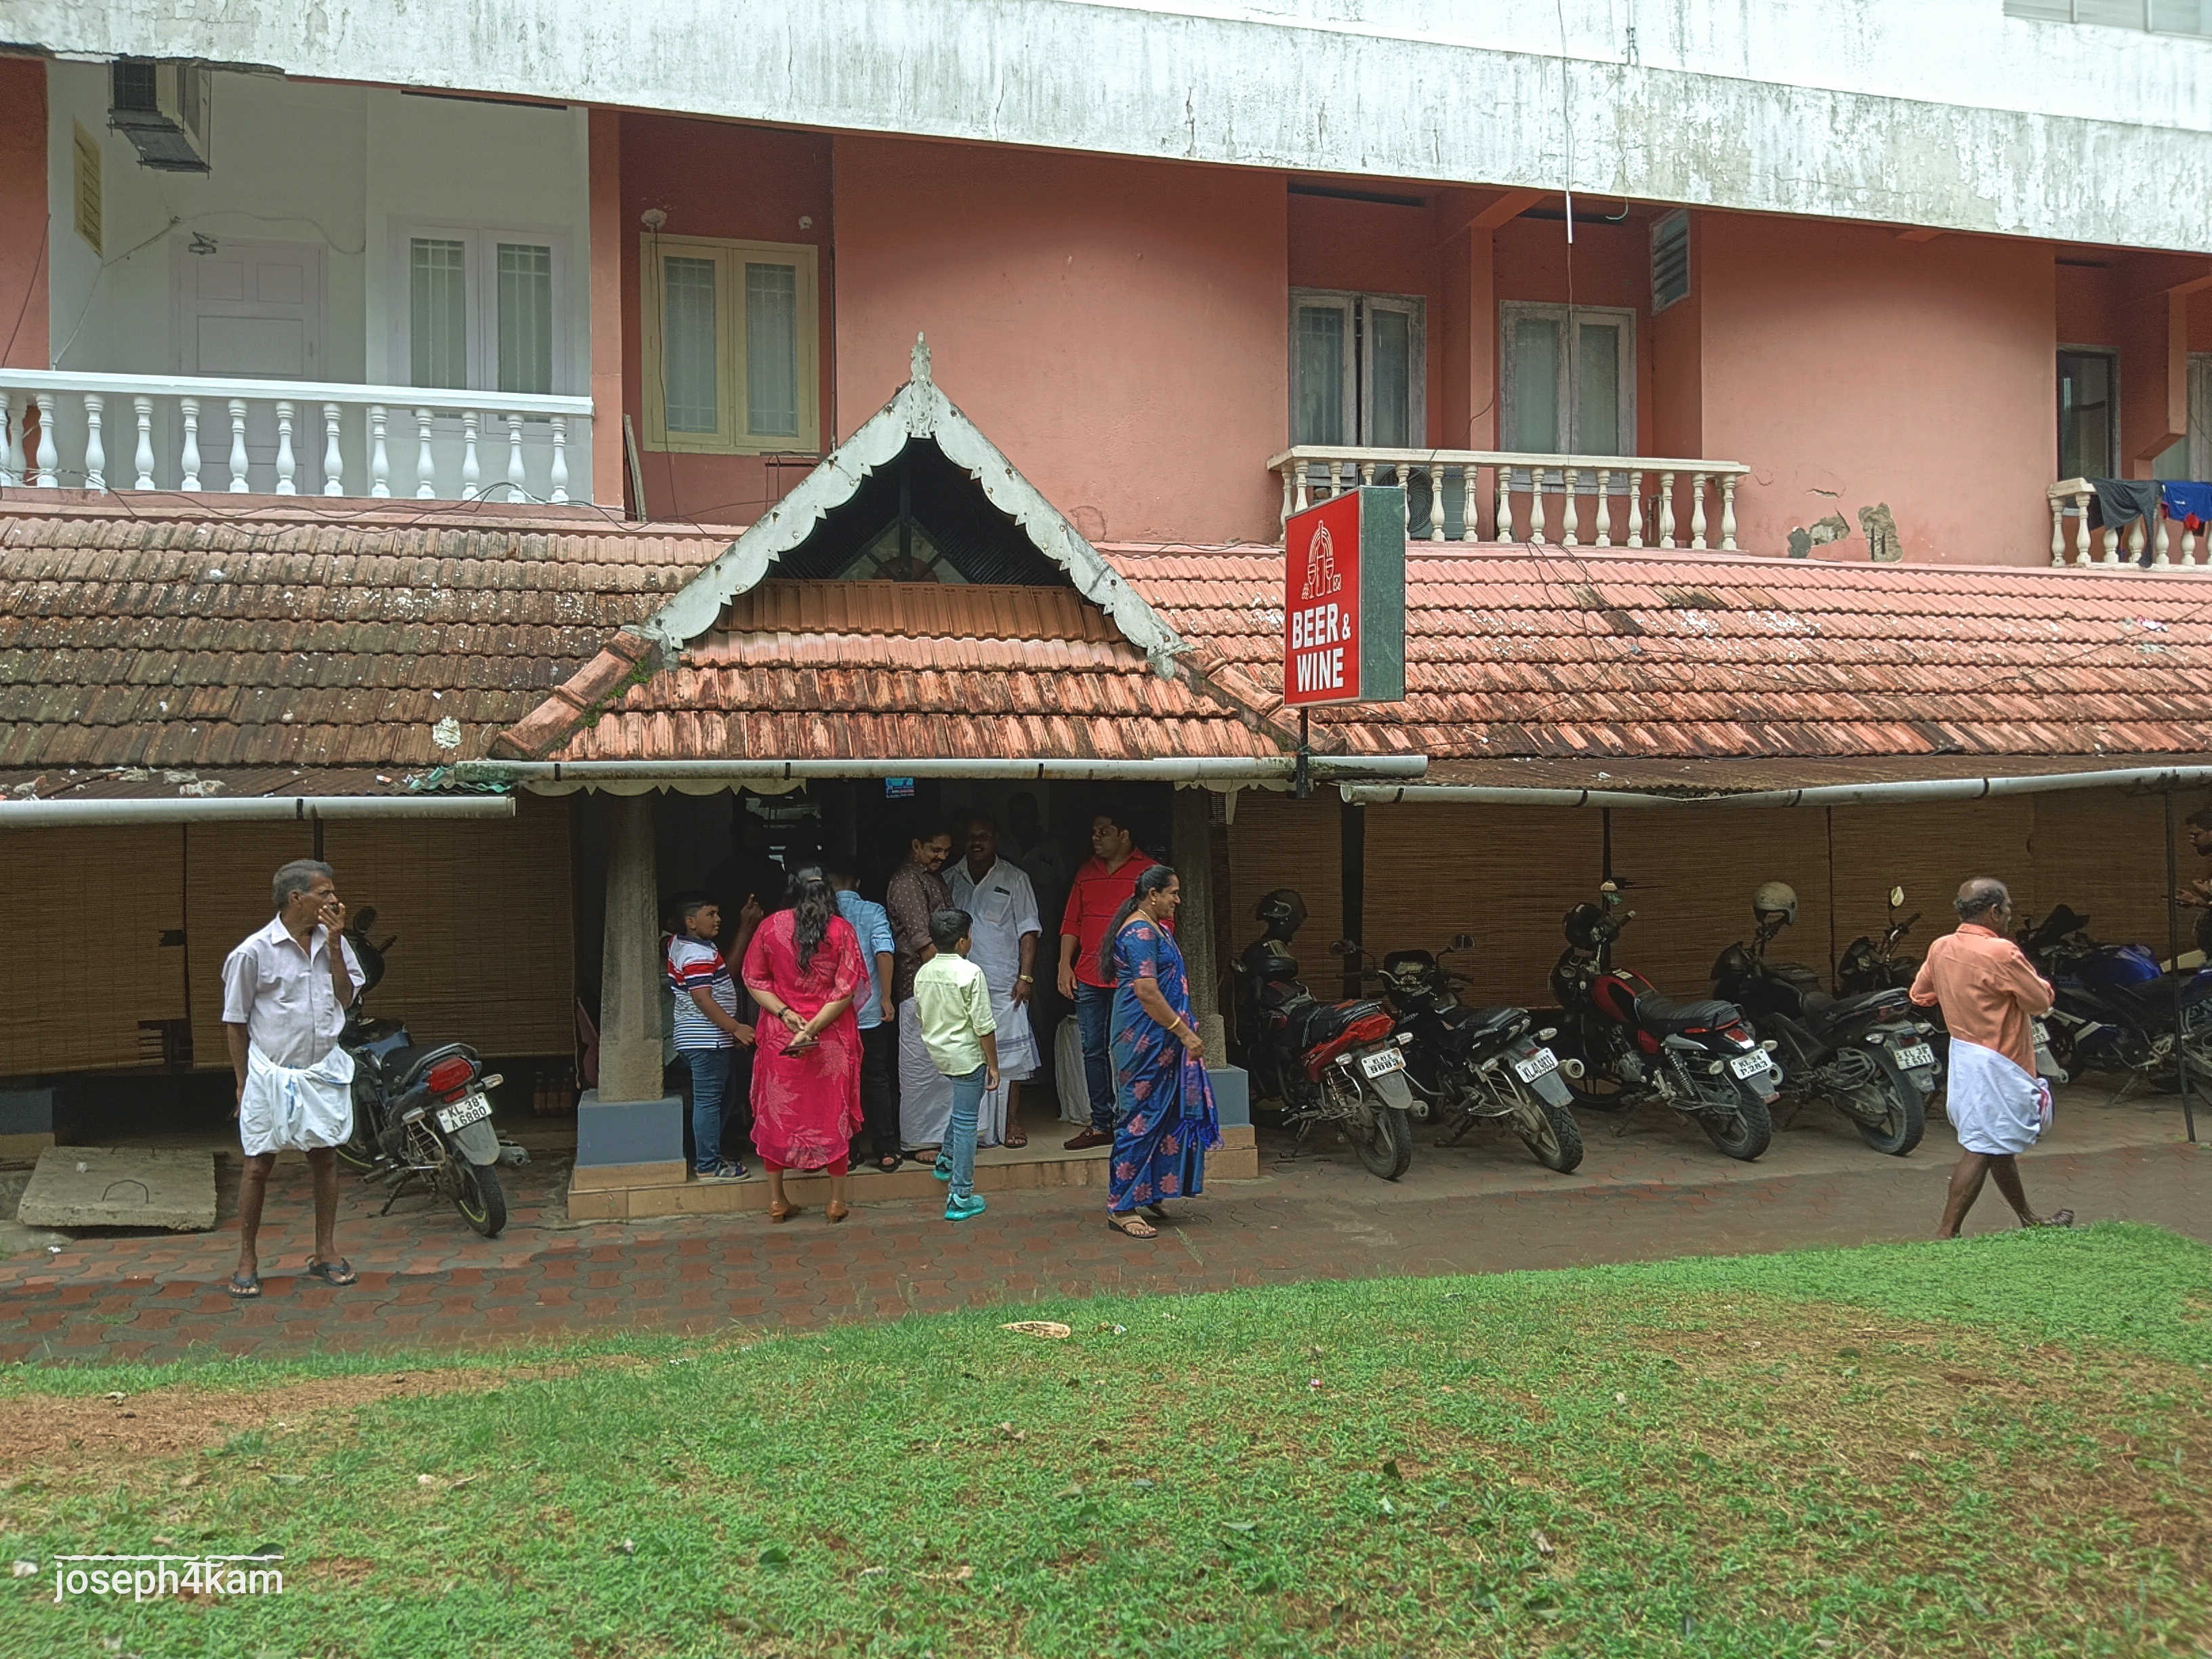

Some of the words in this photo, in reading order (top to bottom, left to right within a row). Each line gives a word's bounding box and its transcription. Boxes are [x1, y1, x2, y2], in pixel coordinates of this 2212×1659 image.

[1292, 603, 1338, 650] BEER
[1342, 613, 1351, 640] &
[1296, 647, 1344, 693] WINE
[447, 1107, 464, 1118] KL
[464, 1098, 480, 1110] 38
[451, 1120, 460, 1130] A
[459, 1106, 487, 1126] 6880
